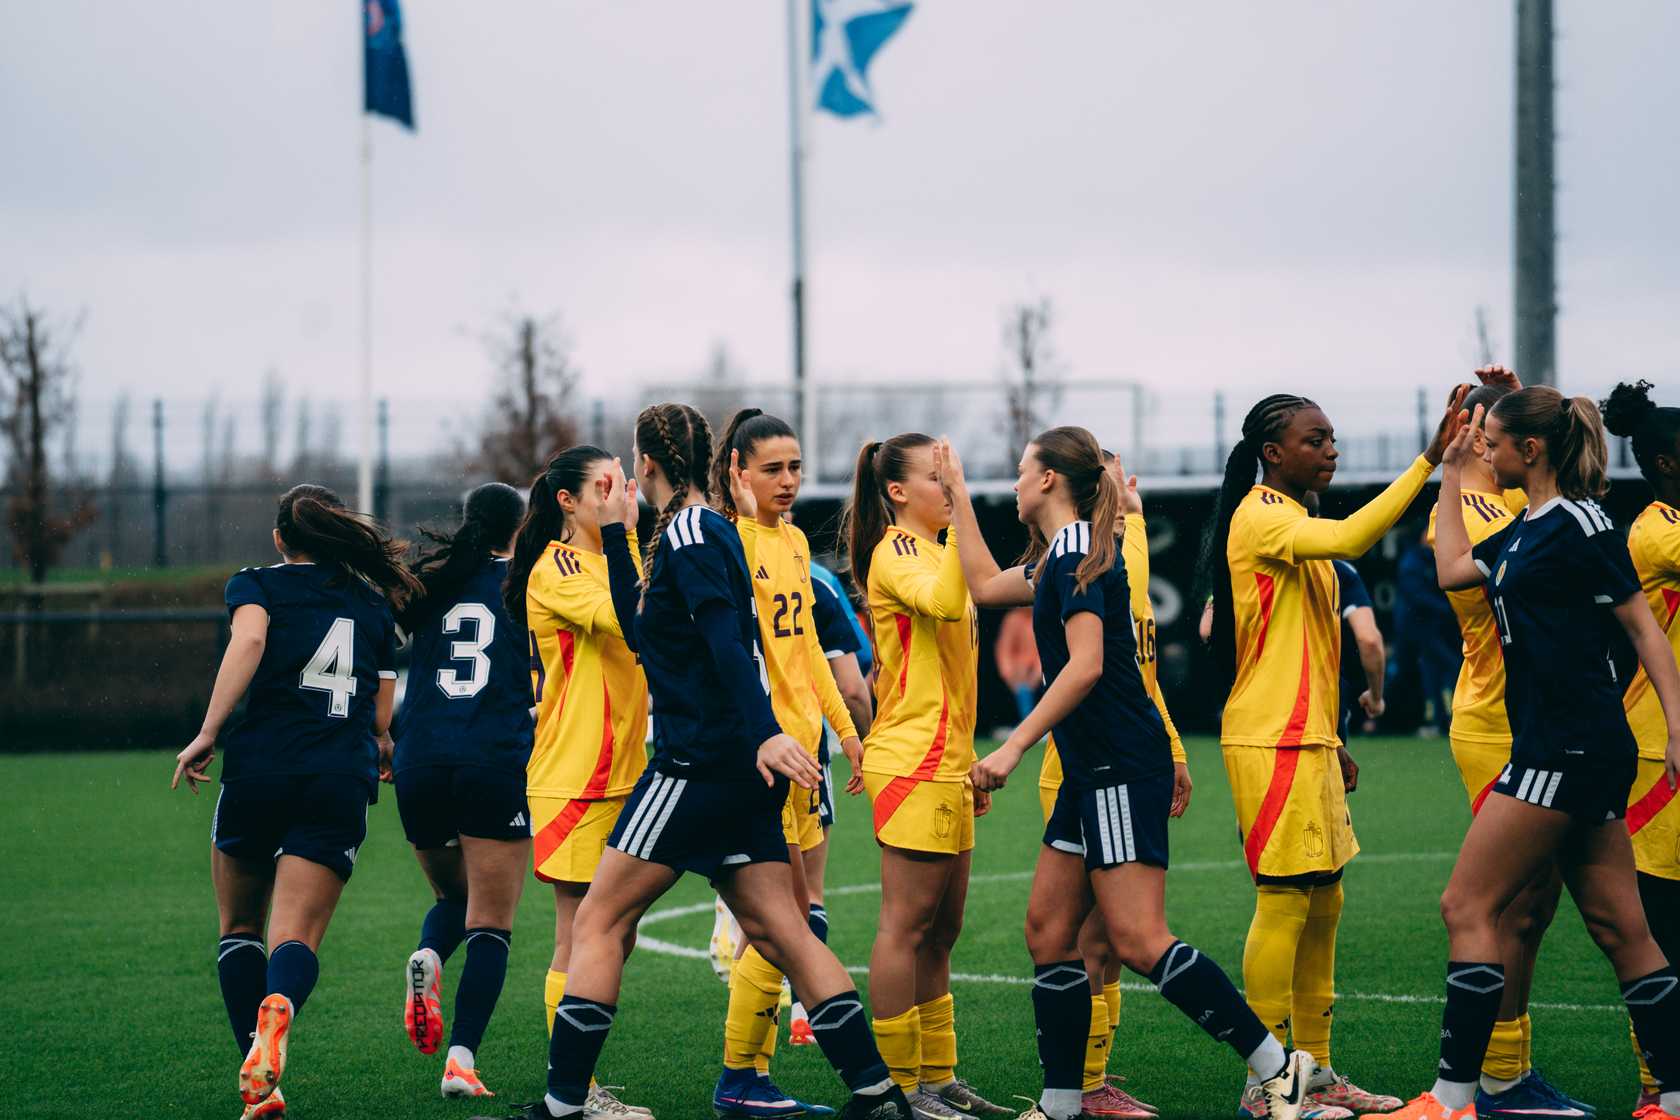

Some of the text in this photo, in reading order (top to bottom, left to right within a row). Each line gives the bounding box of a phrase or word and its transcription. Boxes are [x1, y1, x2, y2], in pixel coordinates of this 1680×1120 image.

[436, 603, 495, 699] 3
[773, 591, 804, 638] 22
[1138, 618, 1155, 665] 16
[299, 617, 358, 718] 4
[411, 959, 428, 1049] PREDATOR
